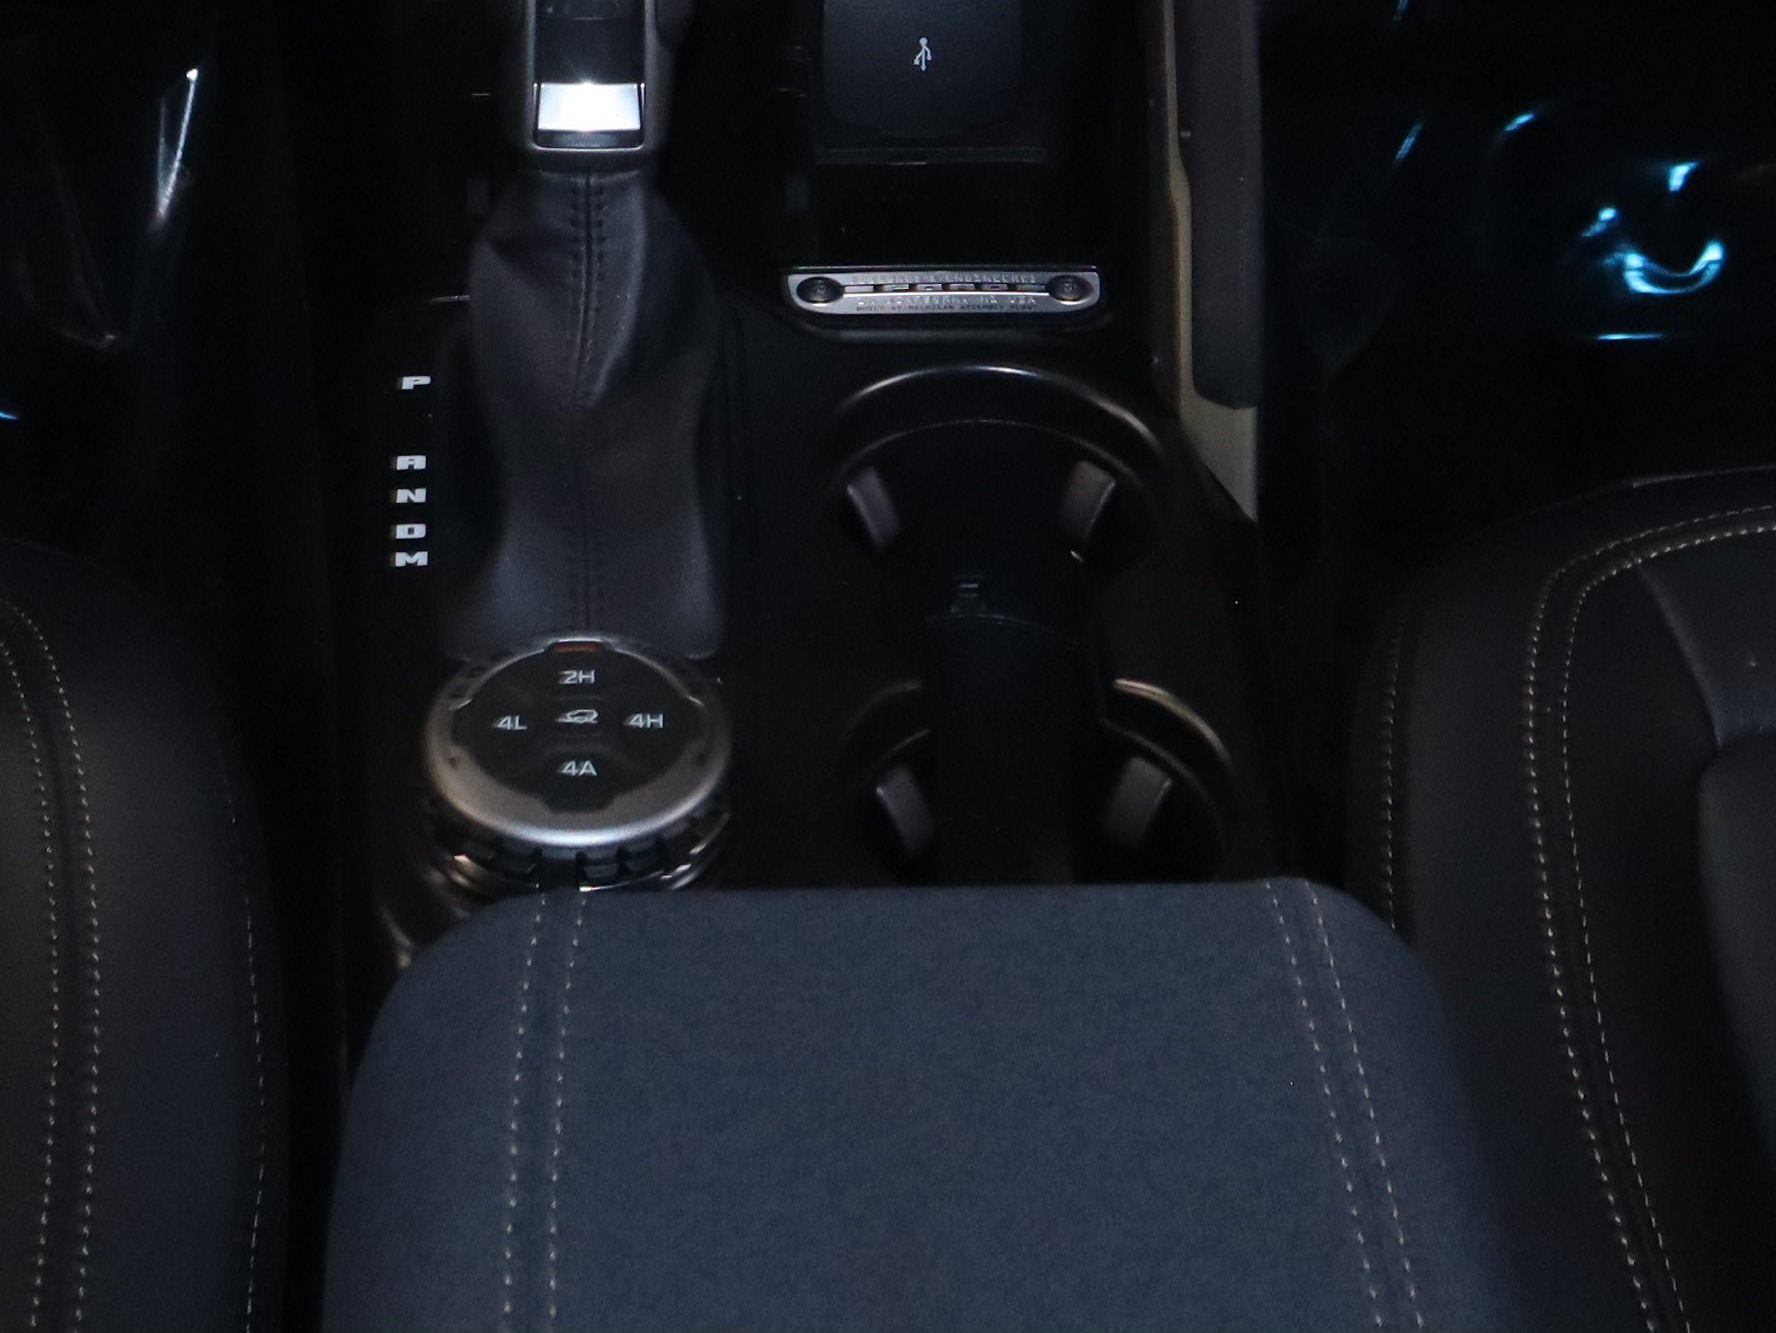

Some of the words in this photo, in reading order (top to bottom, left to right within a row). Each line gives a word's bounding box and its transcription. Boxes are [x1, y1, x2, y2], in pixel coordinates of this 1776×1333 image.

[398, 375, 432, 390] P
[394, 488, 427, 503] N
[393, 551, 429, 567] M
[558, 670, 596, 684] 2H
[494, 715, 527, 730] 4L
[625, 713, 664, 729] 4H
[557, 760, 598, 777] 4A
